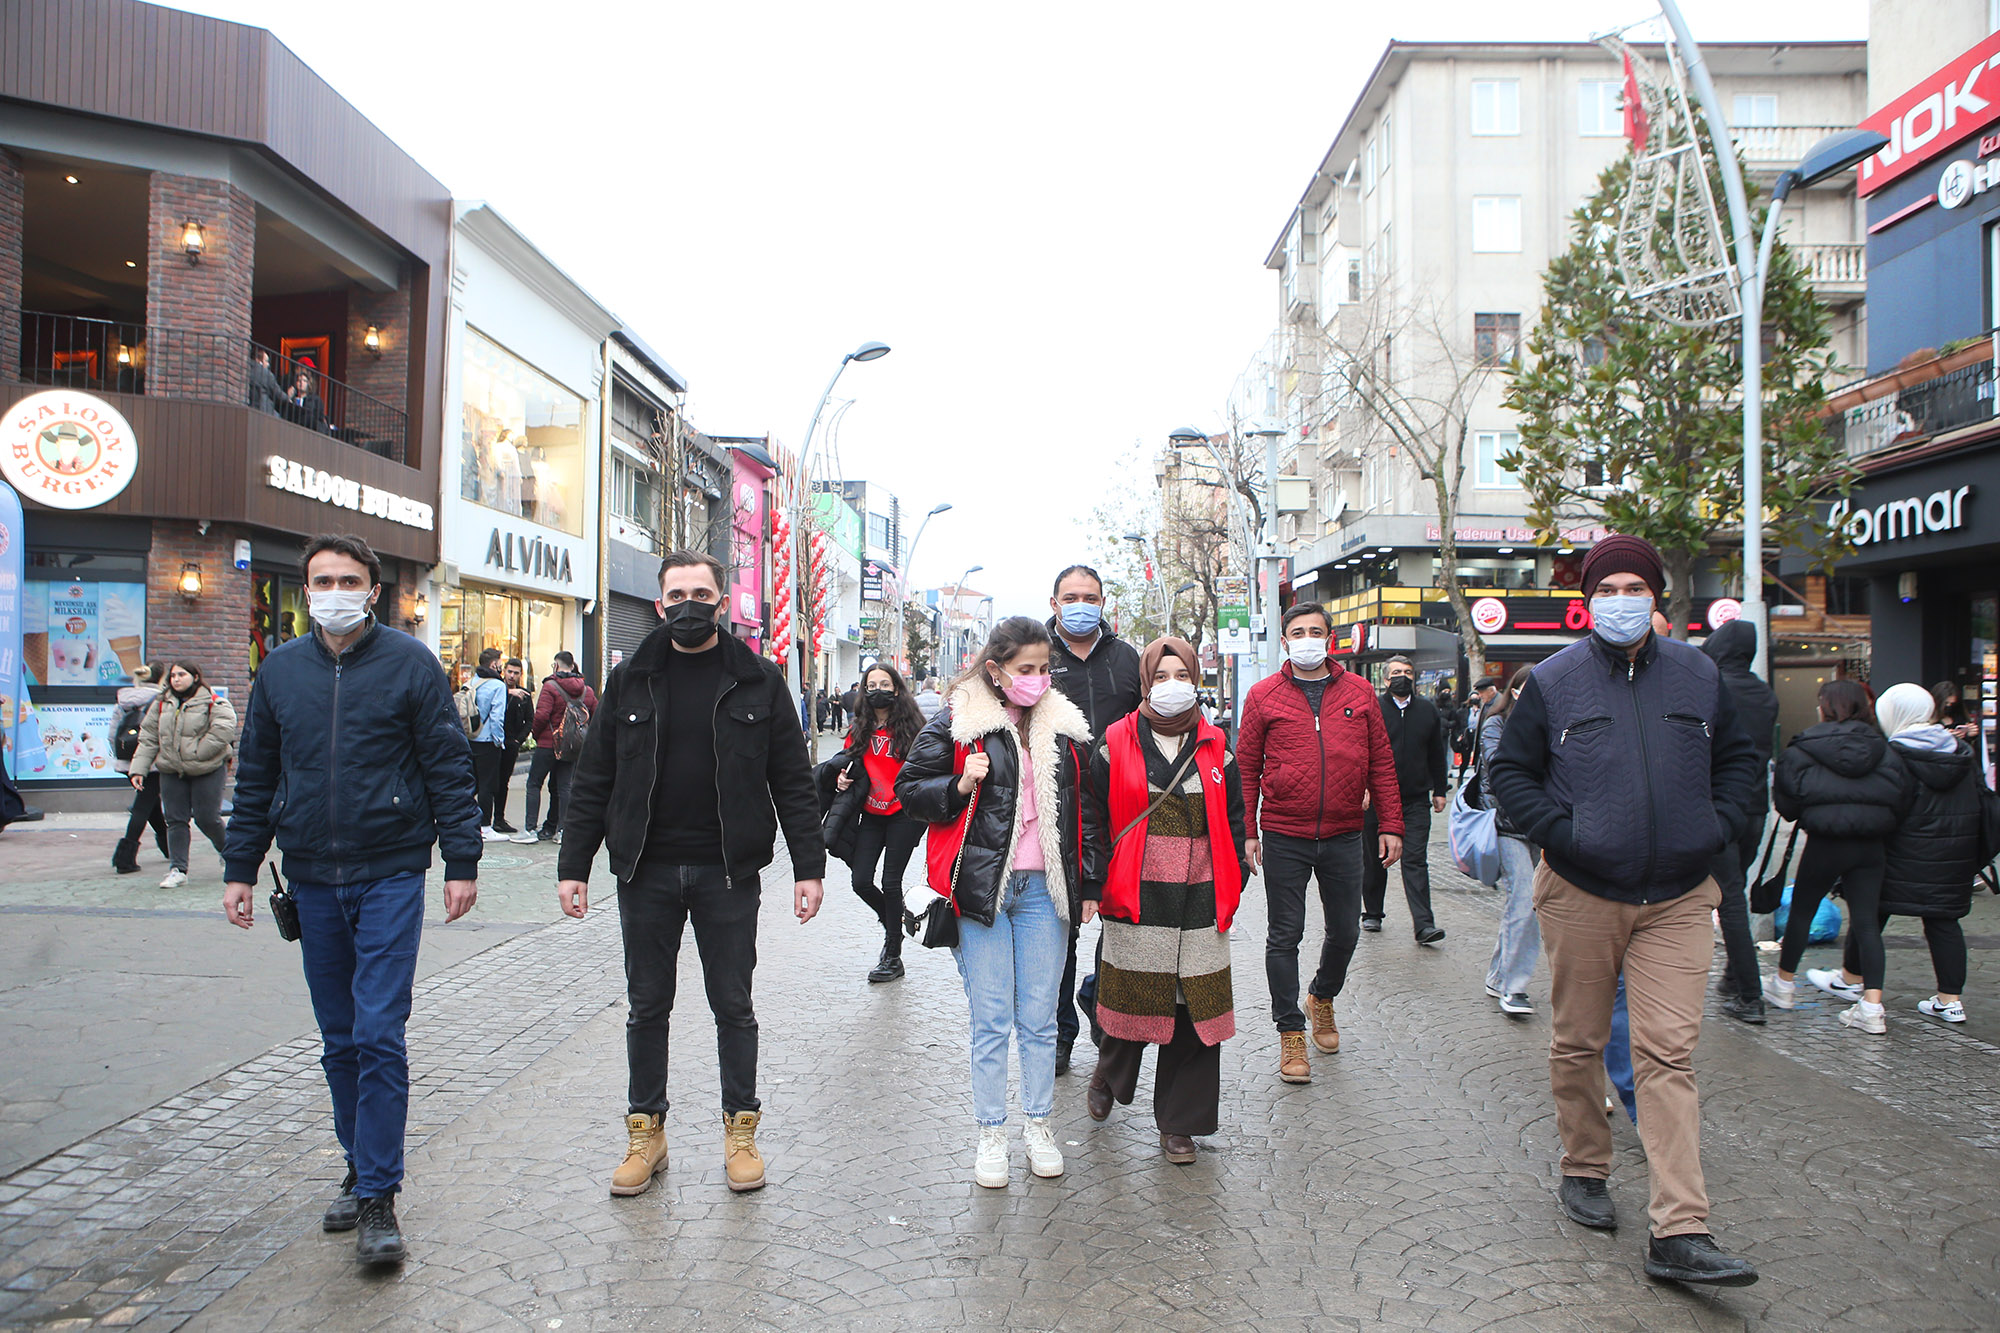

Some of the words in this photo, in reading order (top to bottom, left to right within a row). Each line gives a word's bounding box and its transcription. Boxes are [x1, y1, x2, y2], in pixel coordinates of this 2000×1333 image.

[1862, 52, 2000, 180] NOK
[18, 402, 123, 452] SALOON
[11, 442, 120, 494] BURGER
[269, 455, 361, 510] SALOON
[361, 484, 433, 531] BURGER
[484, 527, 573, 583] ALVİNA
[740, 1117, 753, 1125] CAT
